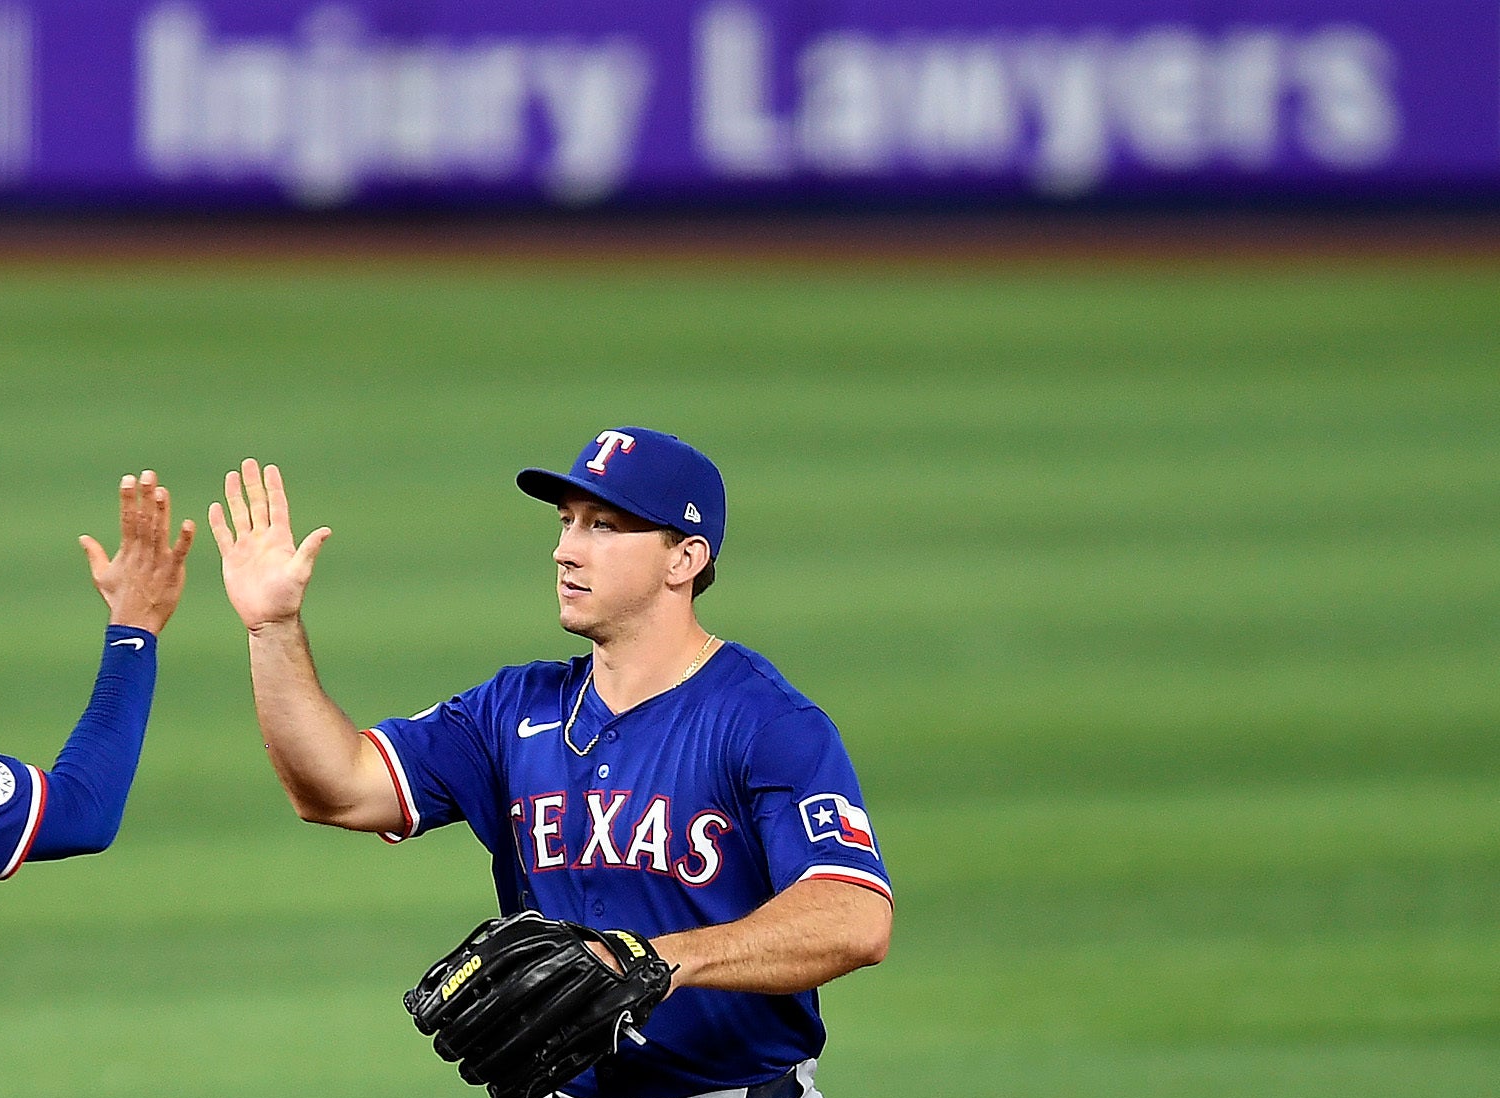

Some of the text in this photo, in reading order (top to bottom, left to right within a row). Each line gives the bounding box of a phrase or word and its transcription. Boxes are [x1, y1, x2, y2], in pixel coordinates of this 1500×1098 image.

[138, 4, 1402, 204] Injury Lawyers
[586, 430, 636, 476] T
[440, 955, 482, 1001] A2000
